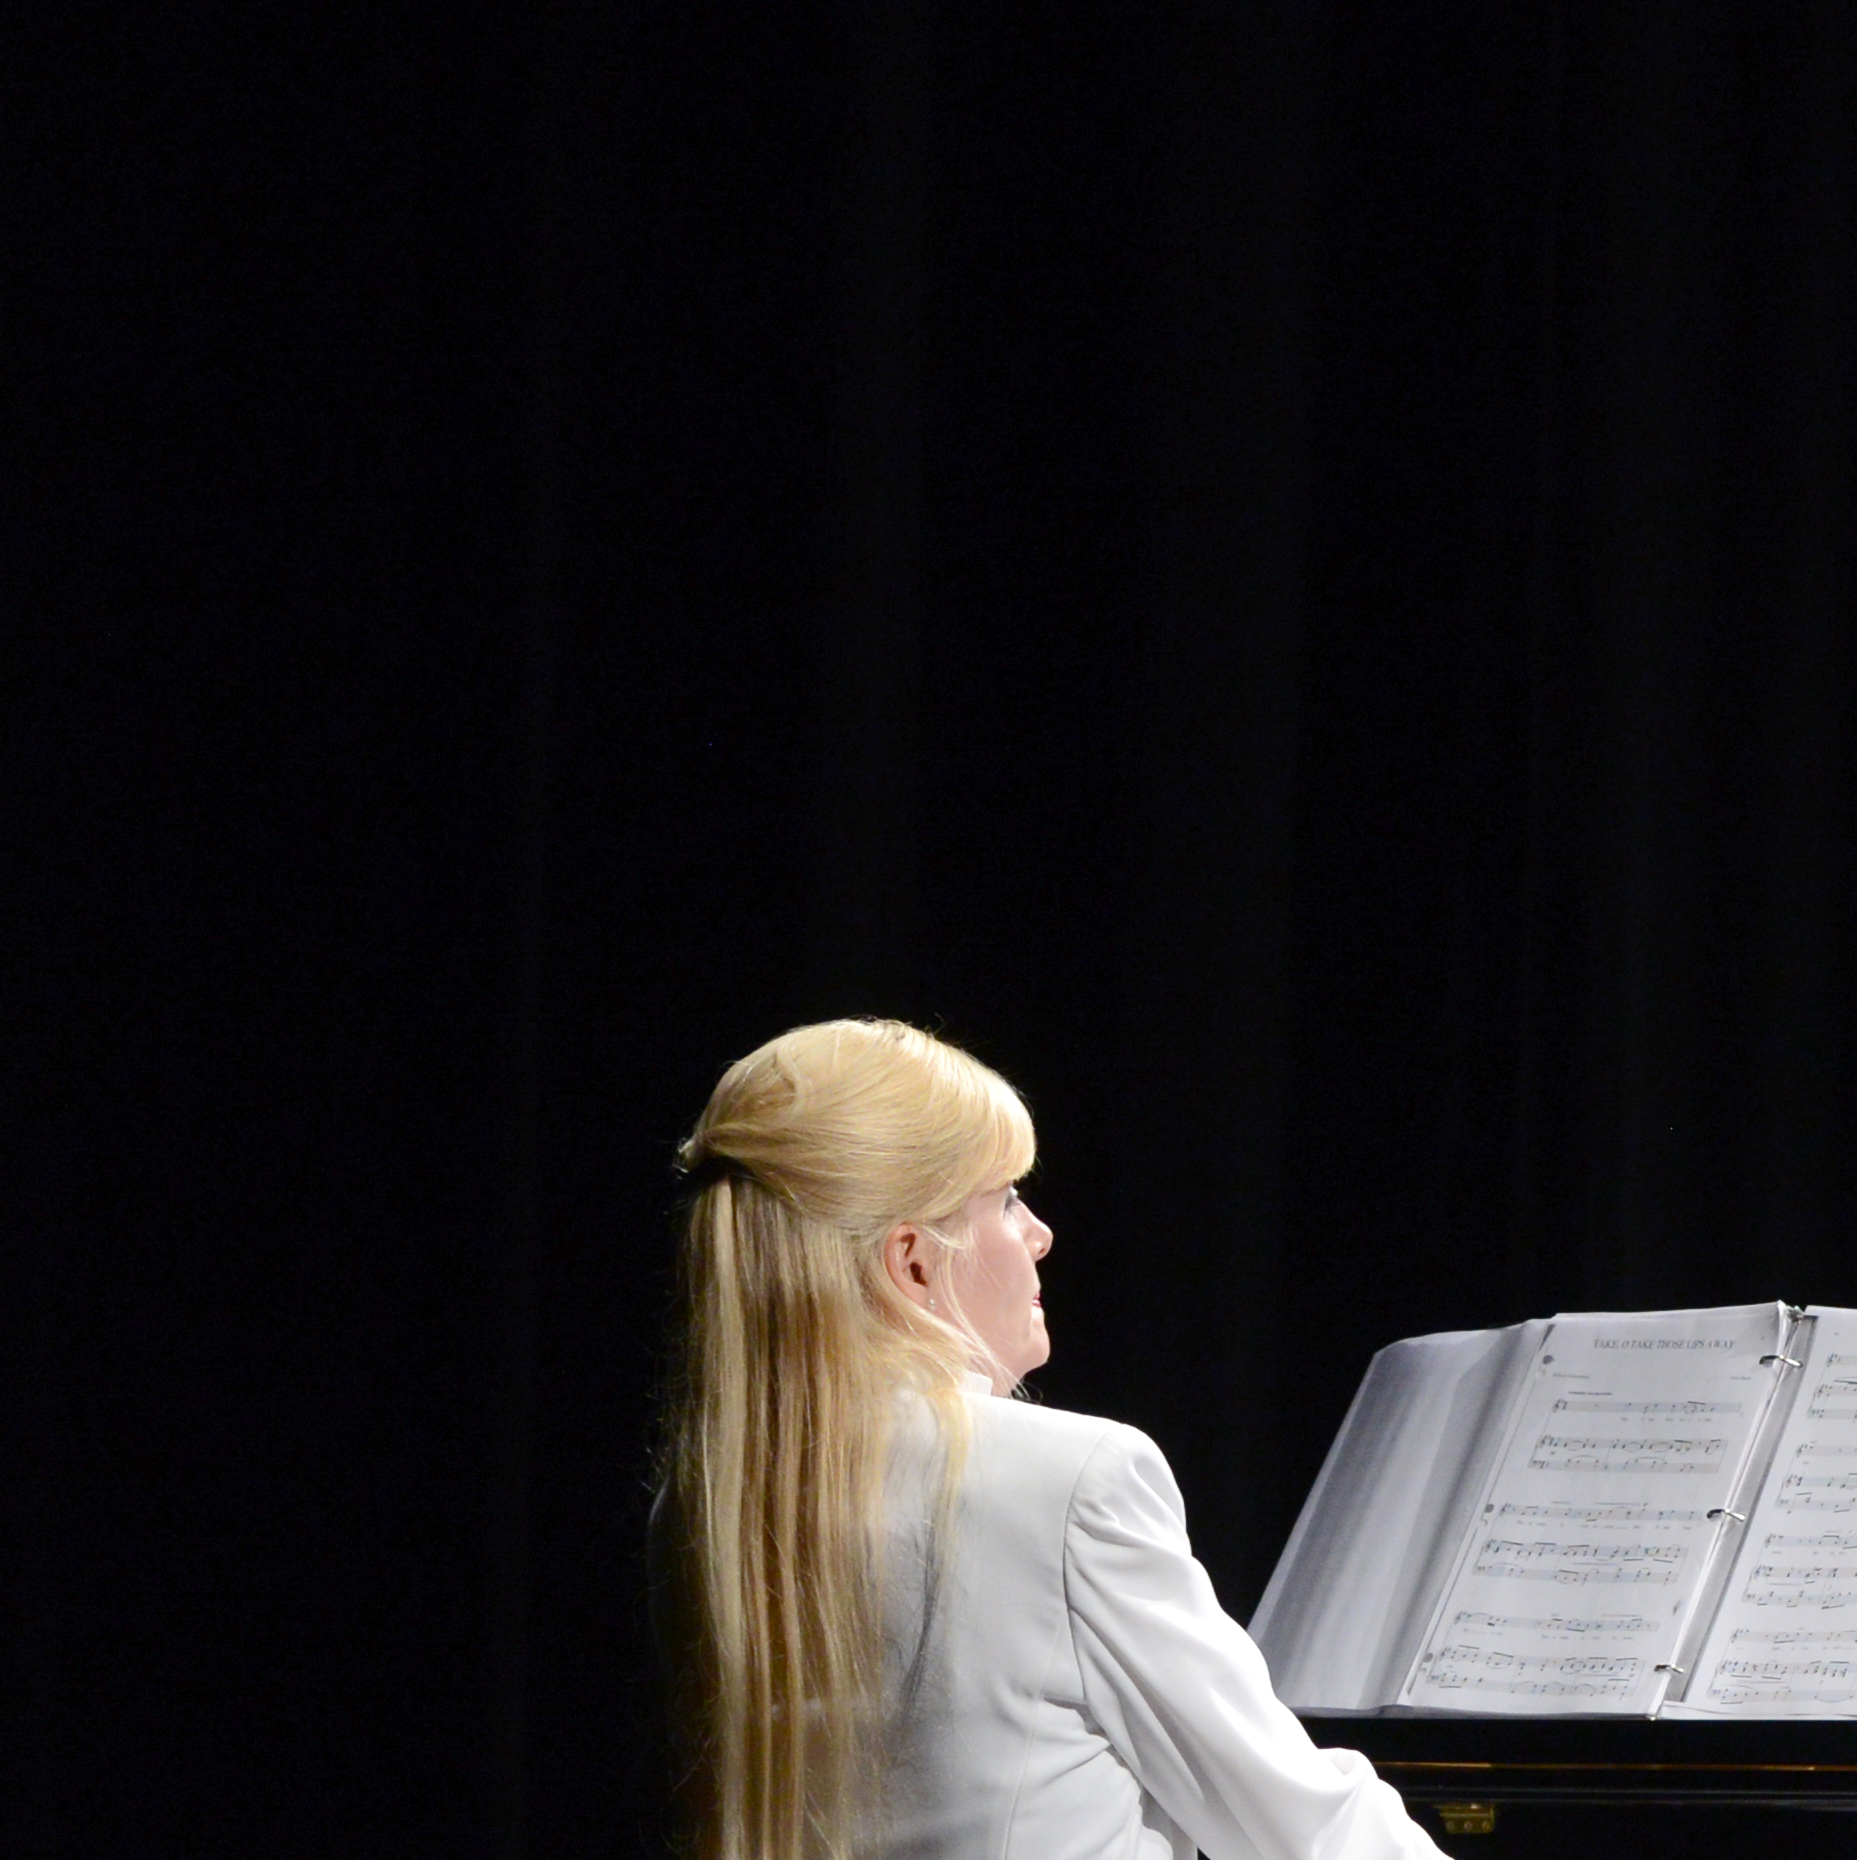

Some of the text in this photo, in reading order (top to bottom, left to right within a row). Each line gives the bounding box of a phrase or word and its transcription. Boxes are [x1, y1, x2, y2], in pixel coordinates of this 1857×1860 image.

[1630, 1339, 1655, 1349] TAKE
[1656, 1339, 1684, 1349] THOSE
[1686, 1339, 1705, 1349] LIPS
[1707, 1339, 1736, 1349] AWAY
